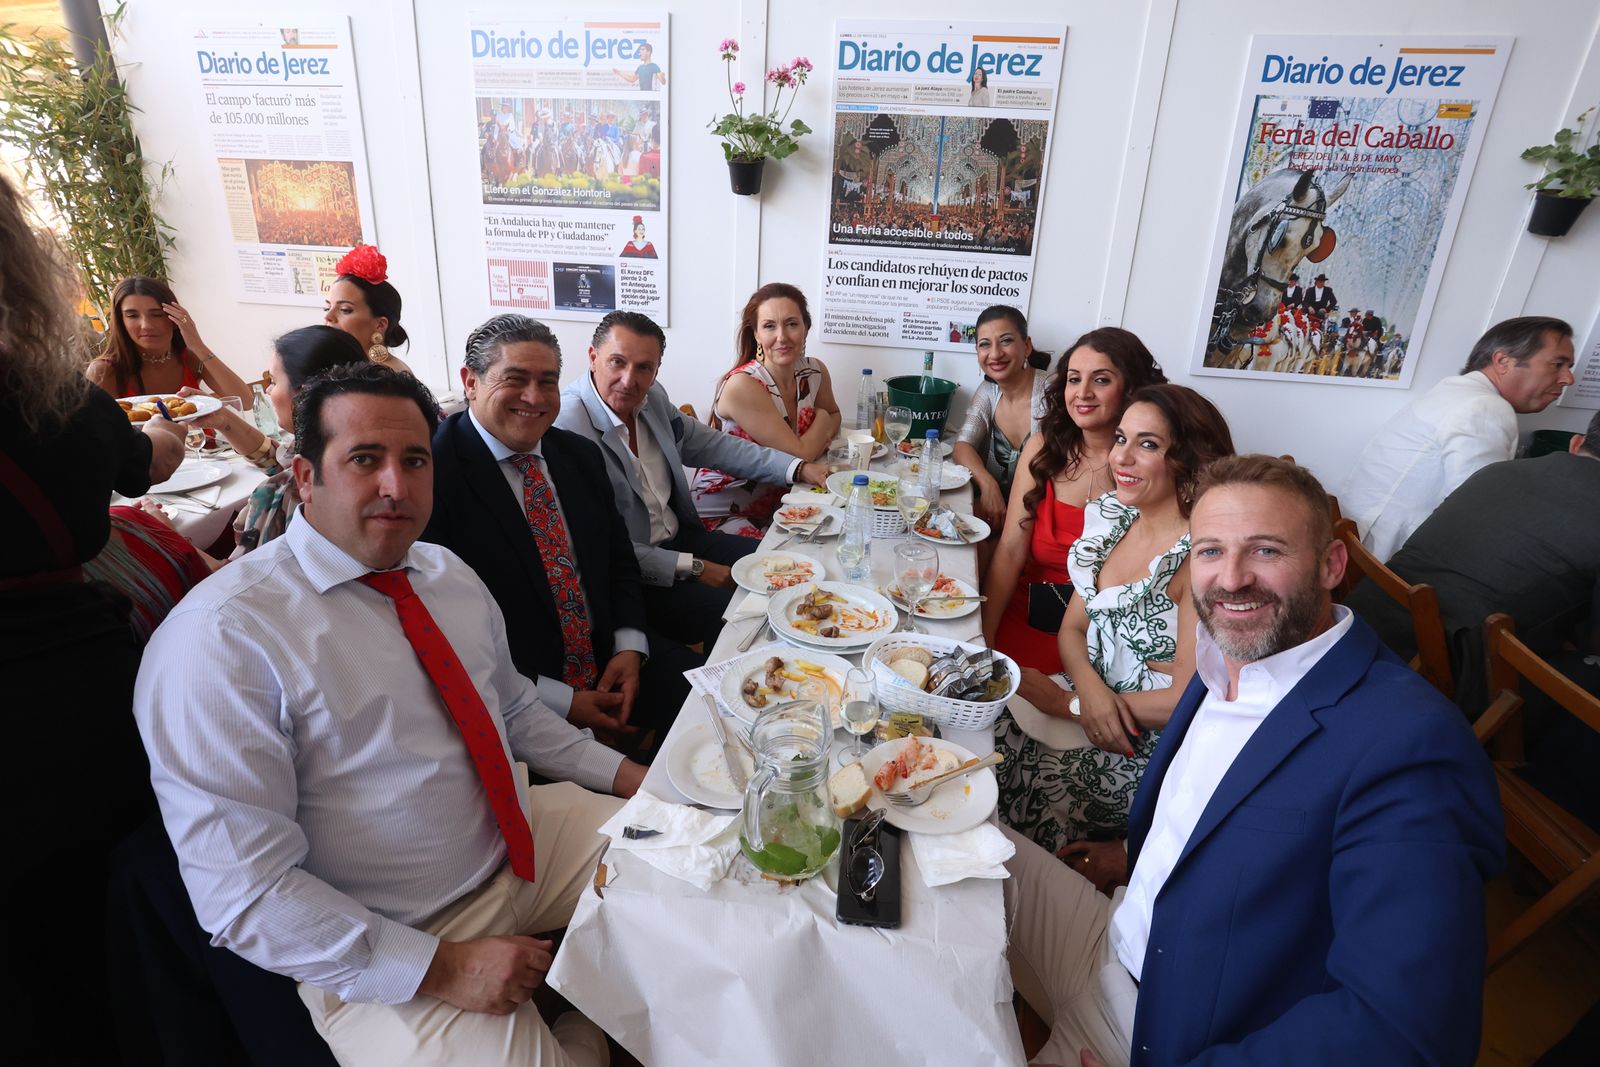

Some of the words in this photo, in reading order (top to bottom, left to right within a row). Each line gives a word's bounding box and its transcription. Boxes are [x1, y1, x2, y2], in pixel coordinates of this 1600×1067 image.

[470, 30, 543, 59] Diario
[548, 30, 579, 59] de
[583, 30, 647, 67] Jerez
[197, 51, 252, 74] Diario
[256, 51, 280, 75] de
[282, 51, 330, 82] Jerez
[838, 40, 921, 72] Diario
[927, 43, 963, 73] de
[966, 44, 1042, 84] Jerez
[1261, 54, 1344, 85] Diario
[1349, 56, 1385, 85] de
[1386, 56, 1465, 95] Jerez
[205, 92, 217, 105] El
[218, 96, 252, 109] campo
[295, 93, 317, 107] más
[209, 112, 222, 124] de
[225, 112, 265, 125] 105.000
[266, 113, 310, 126] millones
[1257, 122, 1315, 146] Feria
[1321, 122, 1357, 148] del
[1364, 125, 1455, 150] Caballo
[1288, 151, 1313, 161] JEREZ
[1316, 152, 1332, 161] DEL
[1335, 153, 1339, 161] 1
[1341, 153, 1351, 161] AL
[1353, 154, 1359, 162] 8
[1361, 154, 1373, 162] DE
[1375, 154, 1402, 163] MAYO
[1288, 161, 1323, 171] Dedicada
[1341, 163, 1364, 173] Unión
[1366, 165, 1399, 175] Europea
[509, 188, 521, 196] en
[521, 186, 531, 196] el
[532, 187, 571, 198] González
[573, 188, 612, 199] Hontoria
[500, 217, 541, 228] Andalucía
[542, 218, 556, 230] hay
[558, 221, 573, 231] que
[574, 221, 616, 231] mantener
[833, 224, 854, 234] Una
[856, 225, 882, 235] Feria
[883, 228, 933, 239] accesible
[935, 231, 942, 239] a
[944, 230, 974, 241] todos
[485, 227, 493, 236] la
[493, 227, 526, 238] fórmula
[527, 229, 537, 239] de
[538, 229, 549, 239] PP
[550, 232, 555, 241] y
[828, 257, 849, 270] Los
[850, 259, 916, 274] candidatos
[918, 263, 969, 279] rehúyen
[971, 265, 986, 279] de
[988, 269, 1028, 282] pactos
[826, 275, 834, 287] y
[836, 274, 879, 288] confían
[882, 279, 896, 288] en
[899, 279, 949, 294] mejorar
[951, 280, 968, 294] los
[970, 283, 1020, 298] sondeos
[831, 313, 854, 321] ministro
[851, 323, 887, 331] investigación
